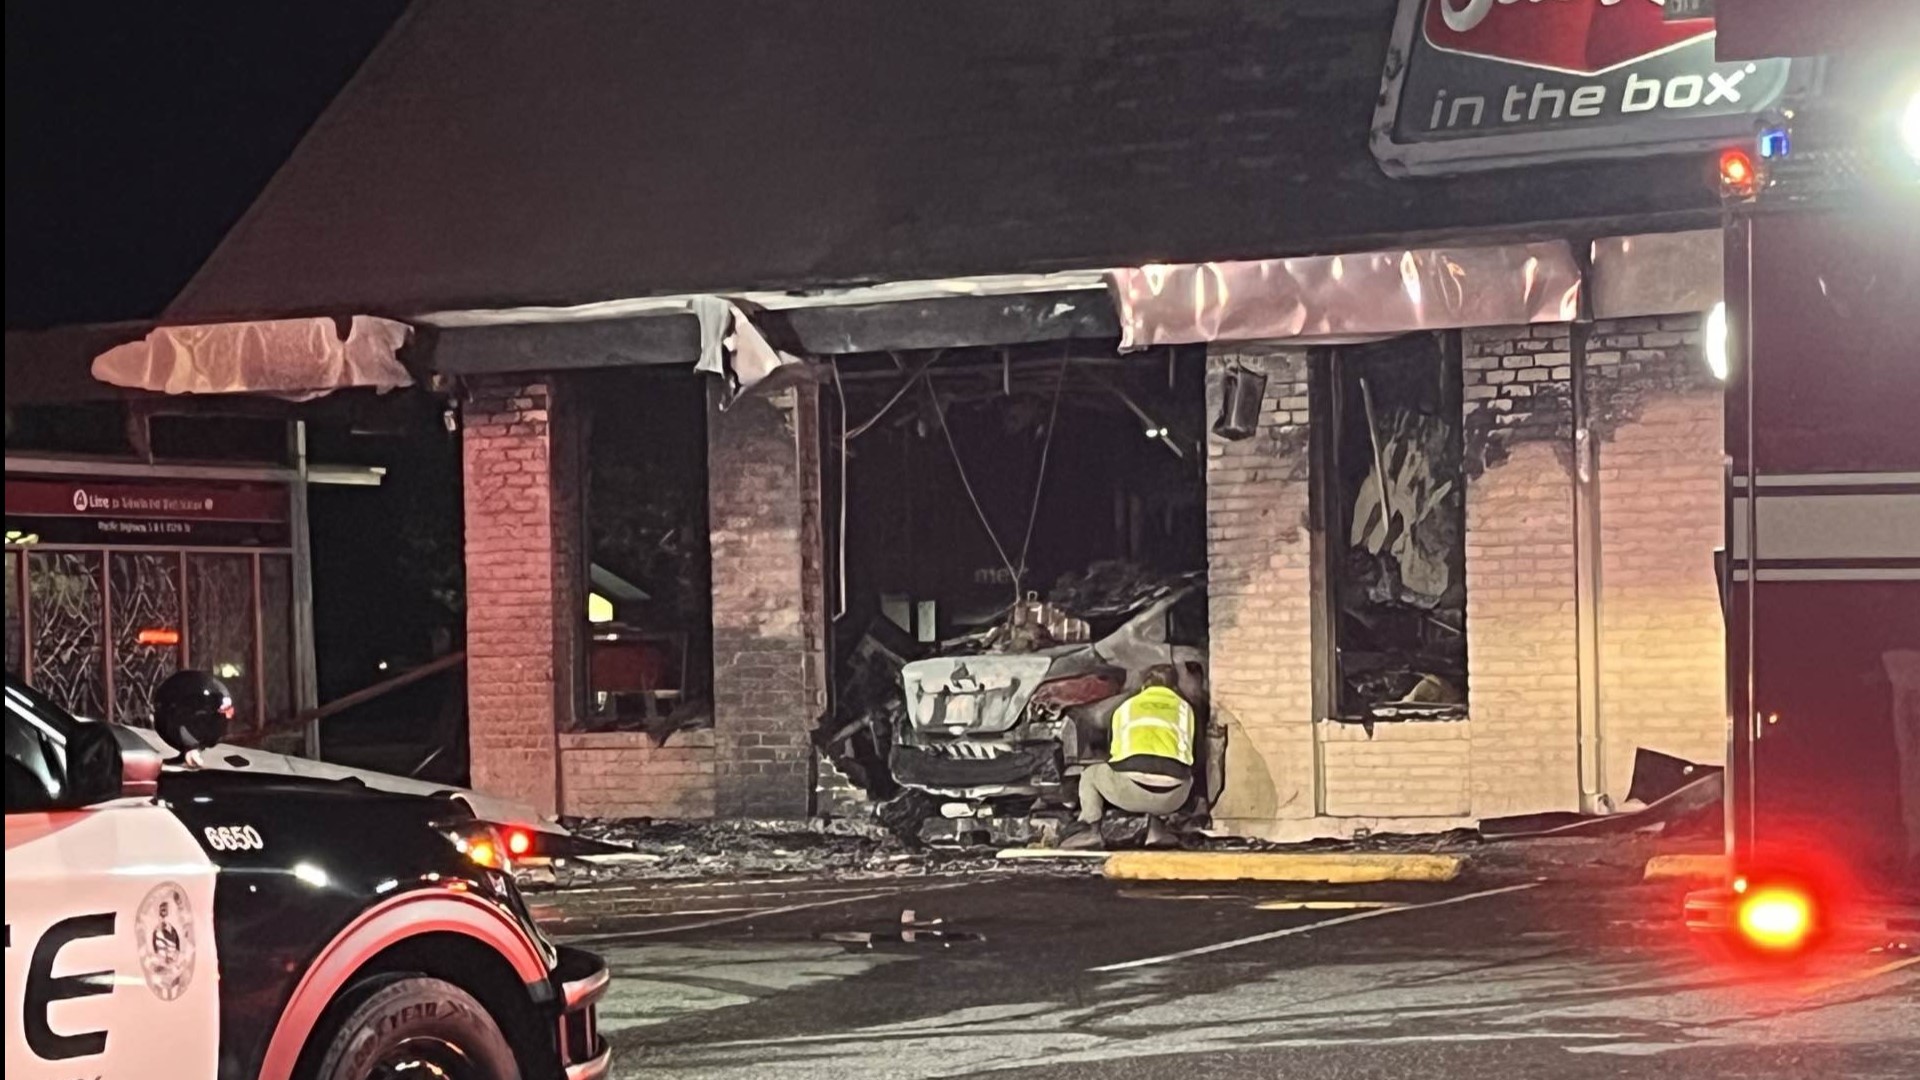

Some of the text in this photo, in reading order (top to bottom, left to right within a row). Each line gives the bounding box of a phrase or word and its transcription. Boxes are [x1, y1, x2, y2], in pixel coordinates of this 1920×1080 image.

[1429, 72, 1744, 129] in the box
[204, 825, 264, 850] 6650
